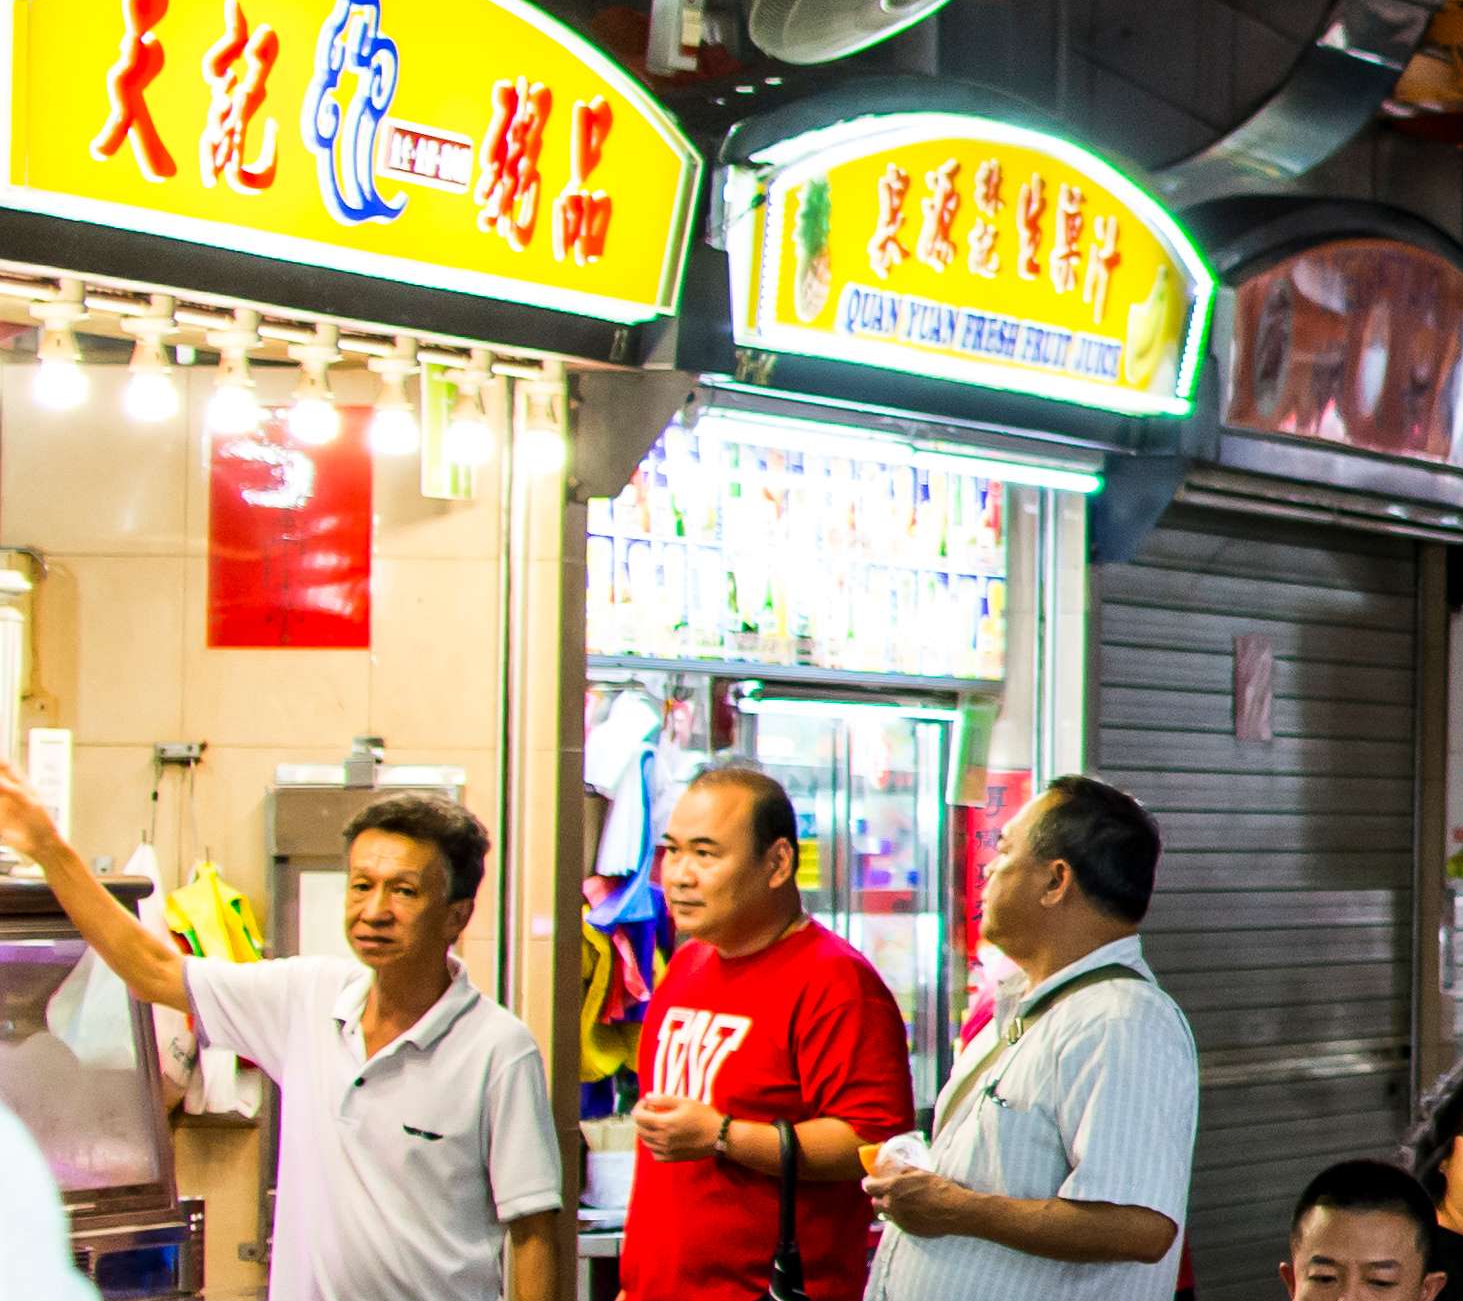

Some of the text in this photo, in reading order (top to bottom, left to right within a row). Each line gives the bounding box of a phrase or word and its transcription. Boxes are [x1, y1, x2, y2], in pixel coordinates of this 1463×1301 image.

[846, 288, 1122, 379] QUAN YUAN FRESH FRUIT JUICE
